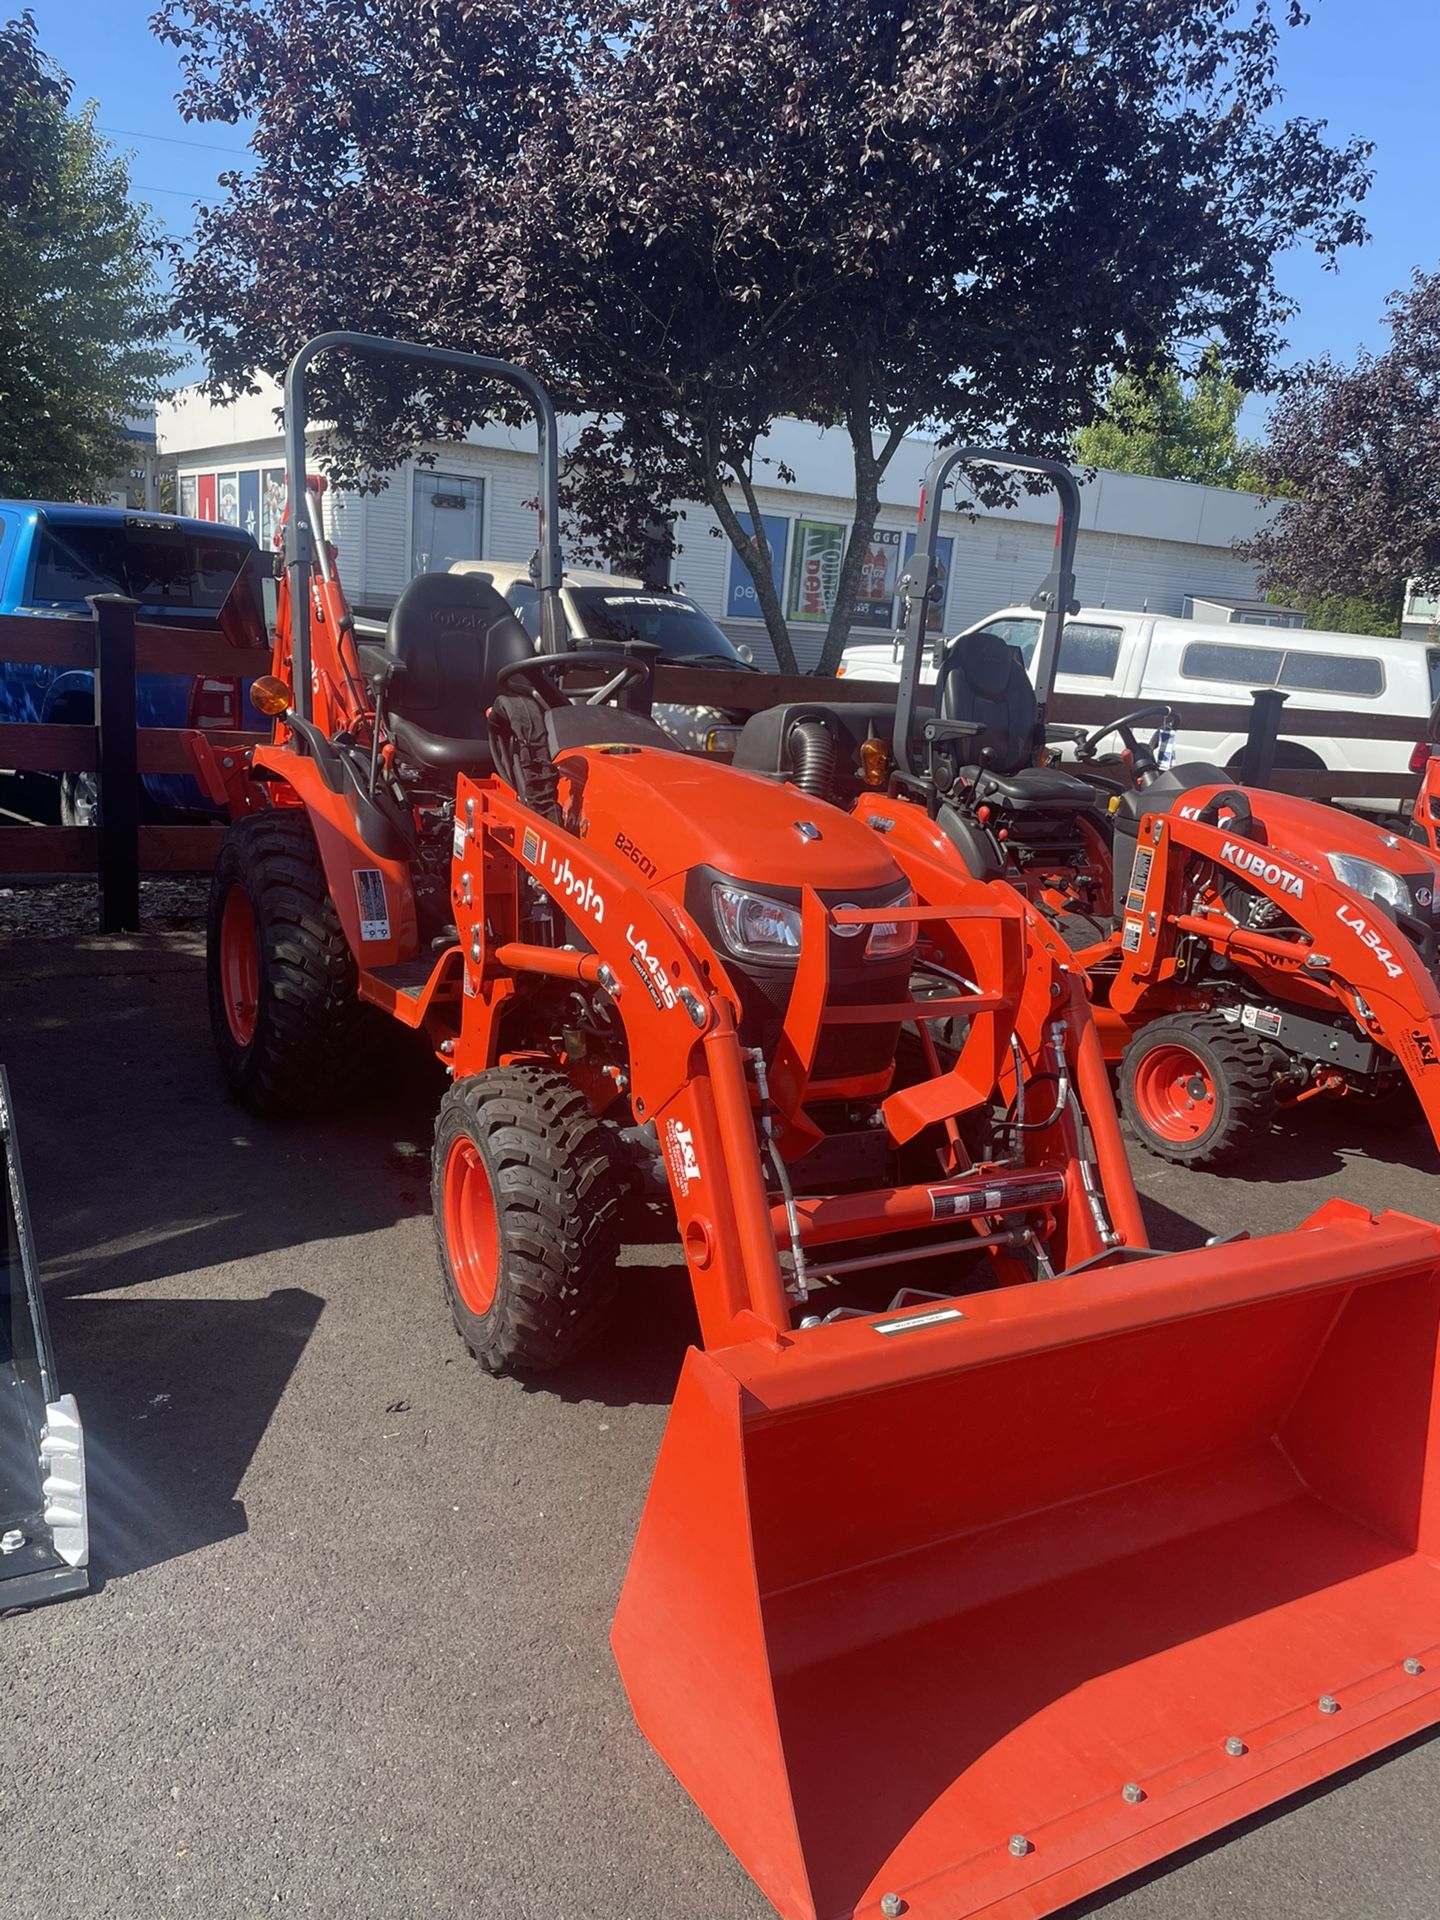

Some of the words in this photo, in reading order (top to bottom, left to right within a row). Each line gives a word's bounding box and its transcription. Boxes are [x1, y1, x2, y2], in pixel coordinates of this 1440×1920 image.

[614, 832, 657, 880] B2601
[1220, 841, 1304, 900] KUBOTA
[626, 924, 678, 1009] LA435
[1336, 905, 1404, 979] LA344
[675, 1121, 701, 1180] J&I
